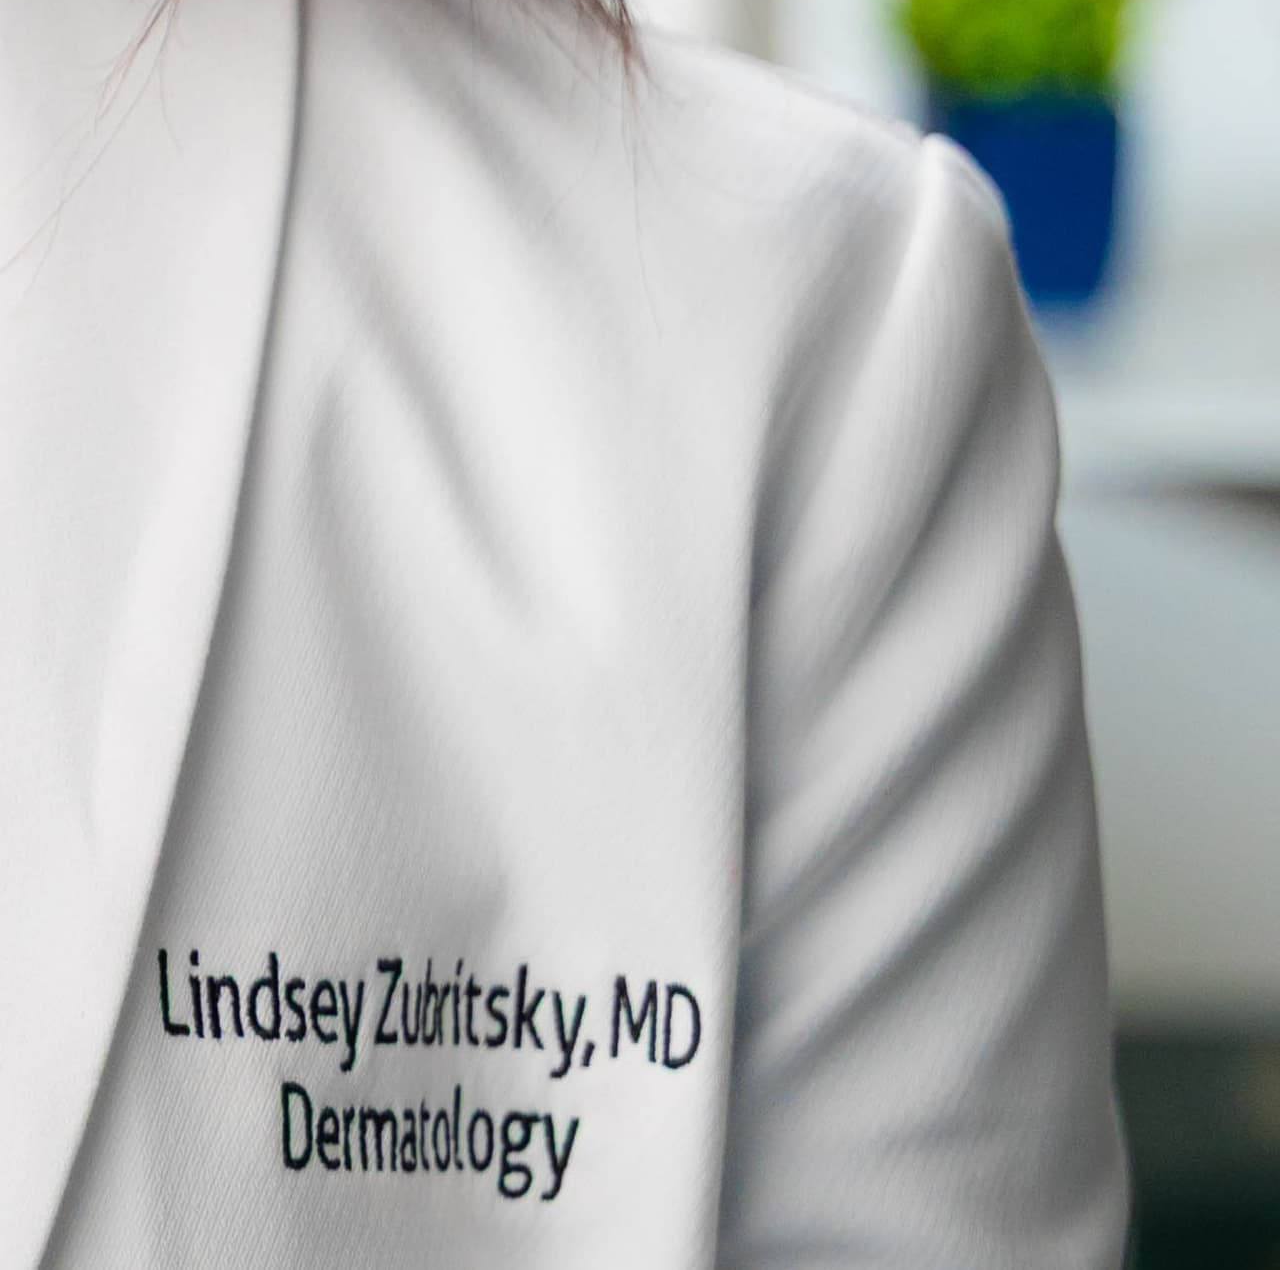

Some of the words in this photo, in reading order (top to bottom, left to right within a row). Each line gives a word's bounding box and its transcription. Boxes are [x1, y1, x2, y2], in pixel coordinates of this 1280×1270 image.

[155, 946, 367, 1075] Lindsey
[371, 956, 596, 1080] Zubritsky,
[608, 974, 703, 1071] MD
[279, 1079, 581, 1202] Dermatology
